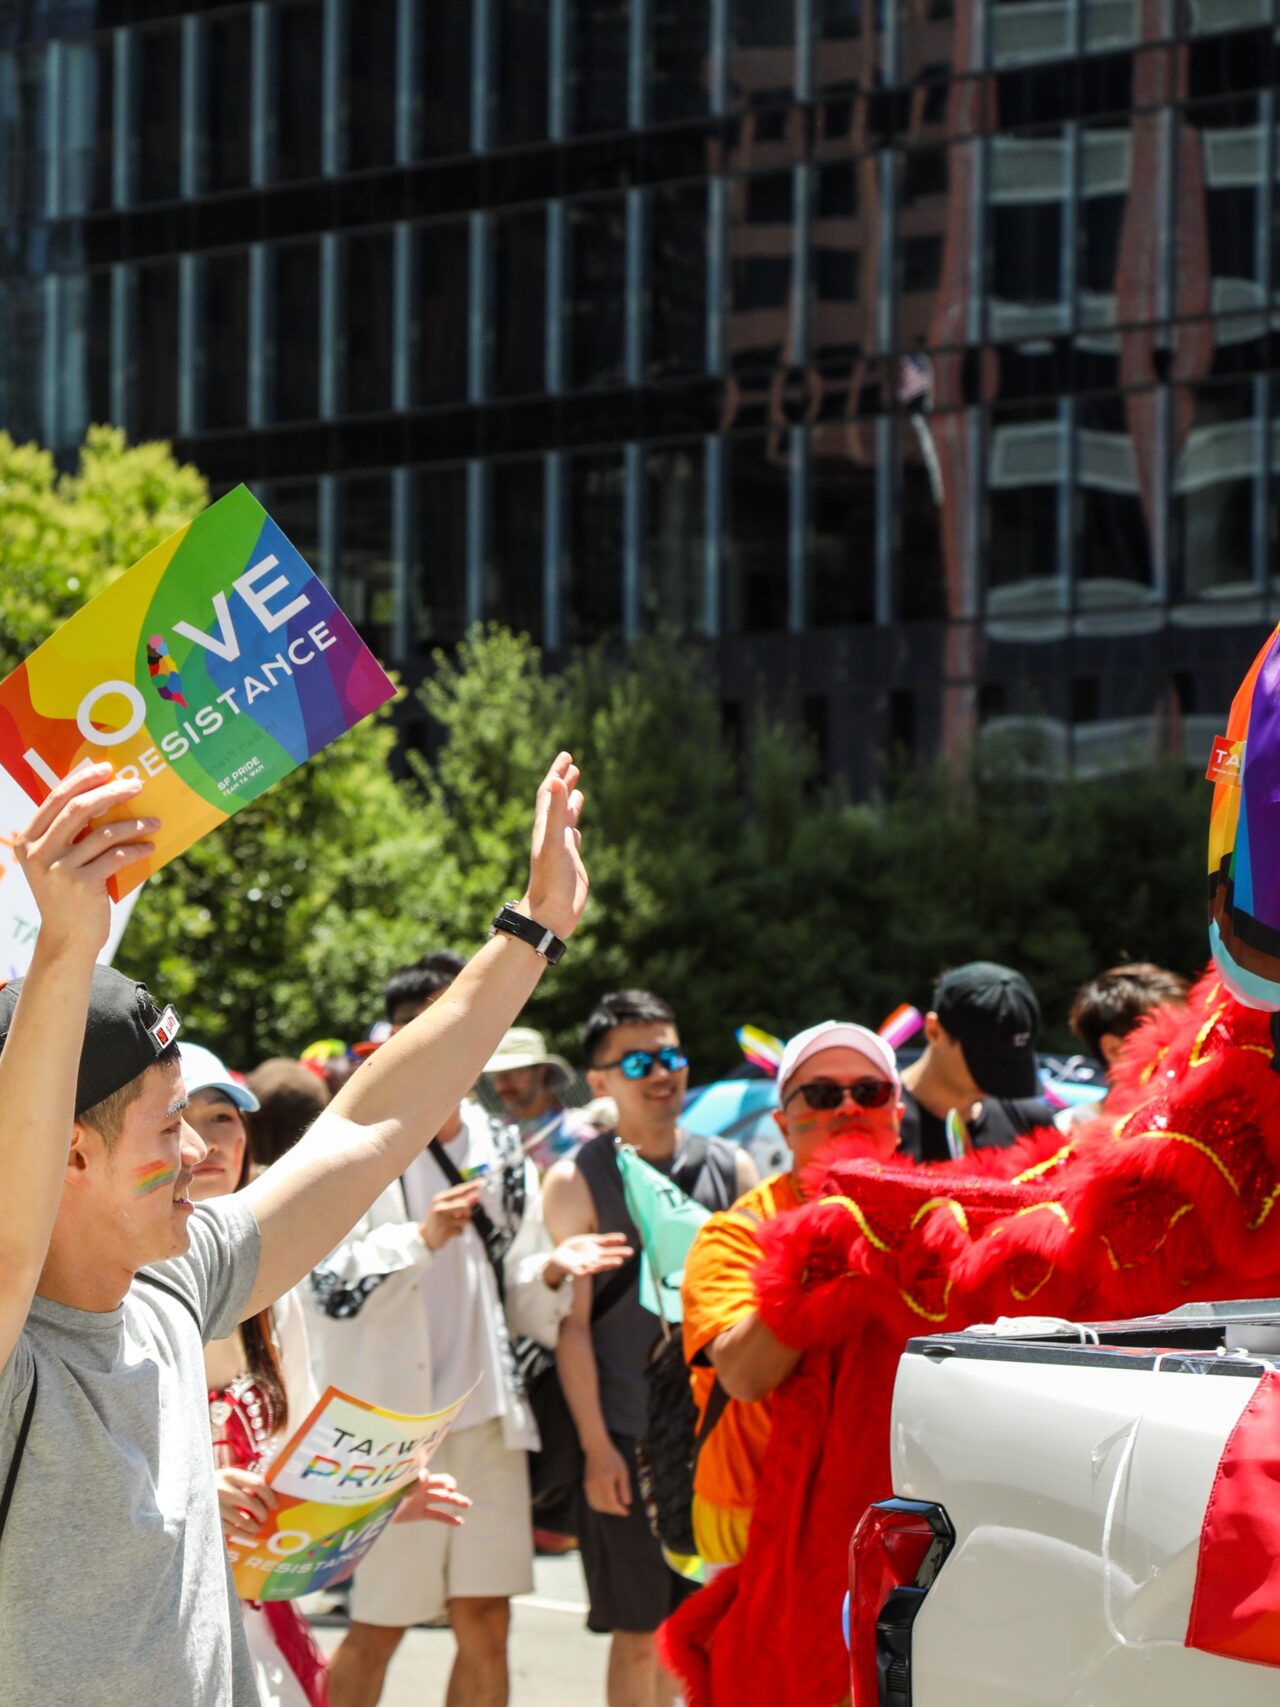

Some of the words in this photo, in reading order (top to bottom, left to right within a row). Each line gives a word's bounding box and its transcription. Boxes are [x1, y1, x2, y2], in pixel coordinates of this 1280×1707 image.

[115, 620, 337, 785] RESISTANCE
[218, 777, 231, 791] SF
[232, 756, 260, 781] PRIDE
[1216, 748, 1241, 767] TA
[300, 1454, 418, 1488] PRID
